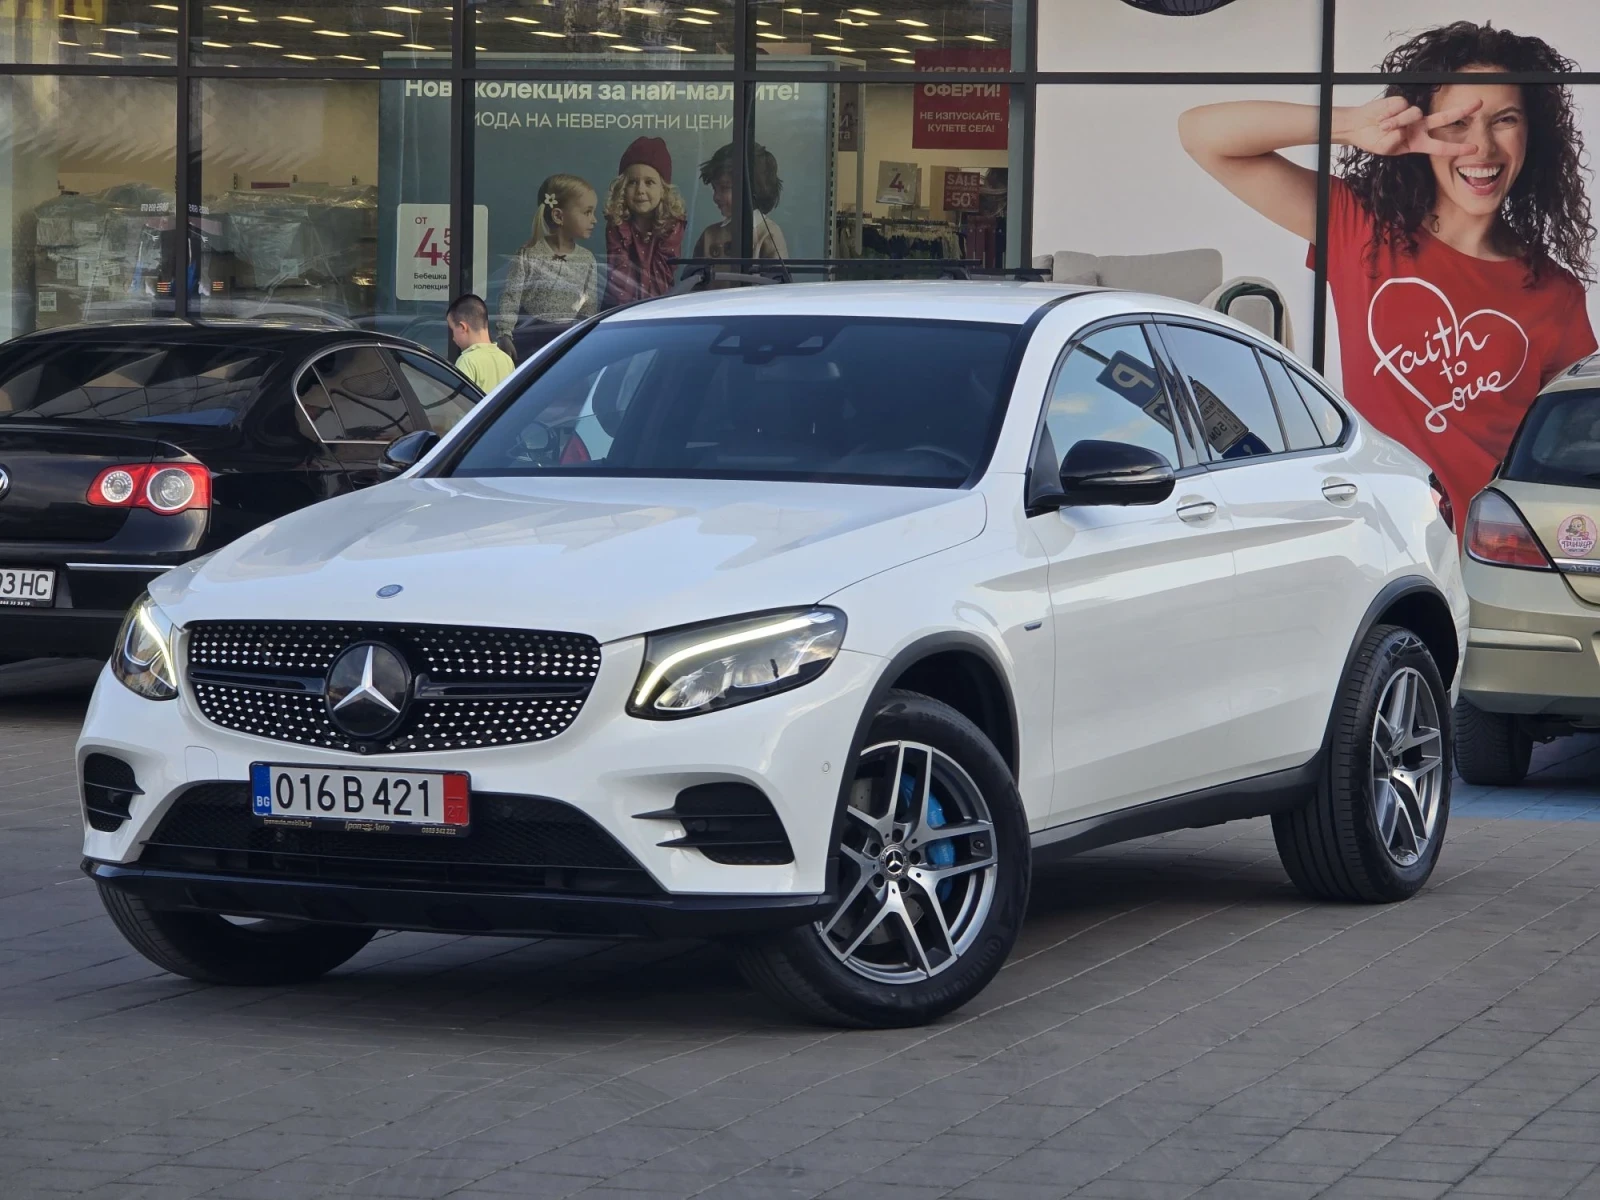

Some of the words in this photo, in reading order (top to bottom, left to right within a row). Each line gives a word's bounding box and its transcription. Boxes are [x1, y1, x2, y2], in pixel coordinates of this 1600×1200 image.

[405, 79, 452, 97] Нов
[475, 82, 592, 103] колекция
[598, 84, 626, 100] за
[631, 81, 800, 101] най-малите!
[923, 83, 1001, 97] ОФЕРТИ!
[526, 112, 552, 128] НА
[556, 113, 680, 129] НЕВЕРОЯТНИ
[920, 111, 934, 120] НЕ
[935, 110, 1003, 122] ИЗПУСКАЙТЕ,
[927, 123, 967, 132] КУПЕТЕ
[968, 124, 995, 133] СЕГА!
[946, 173, 978, 186] SALE
[413, 272, 447, 280] Бебешка
[1439, 358, 1468, 384] to
[19, 573, 49, 596] HC
[256, 795, 270, 808] BG
